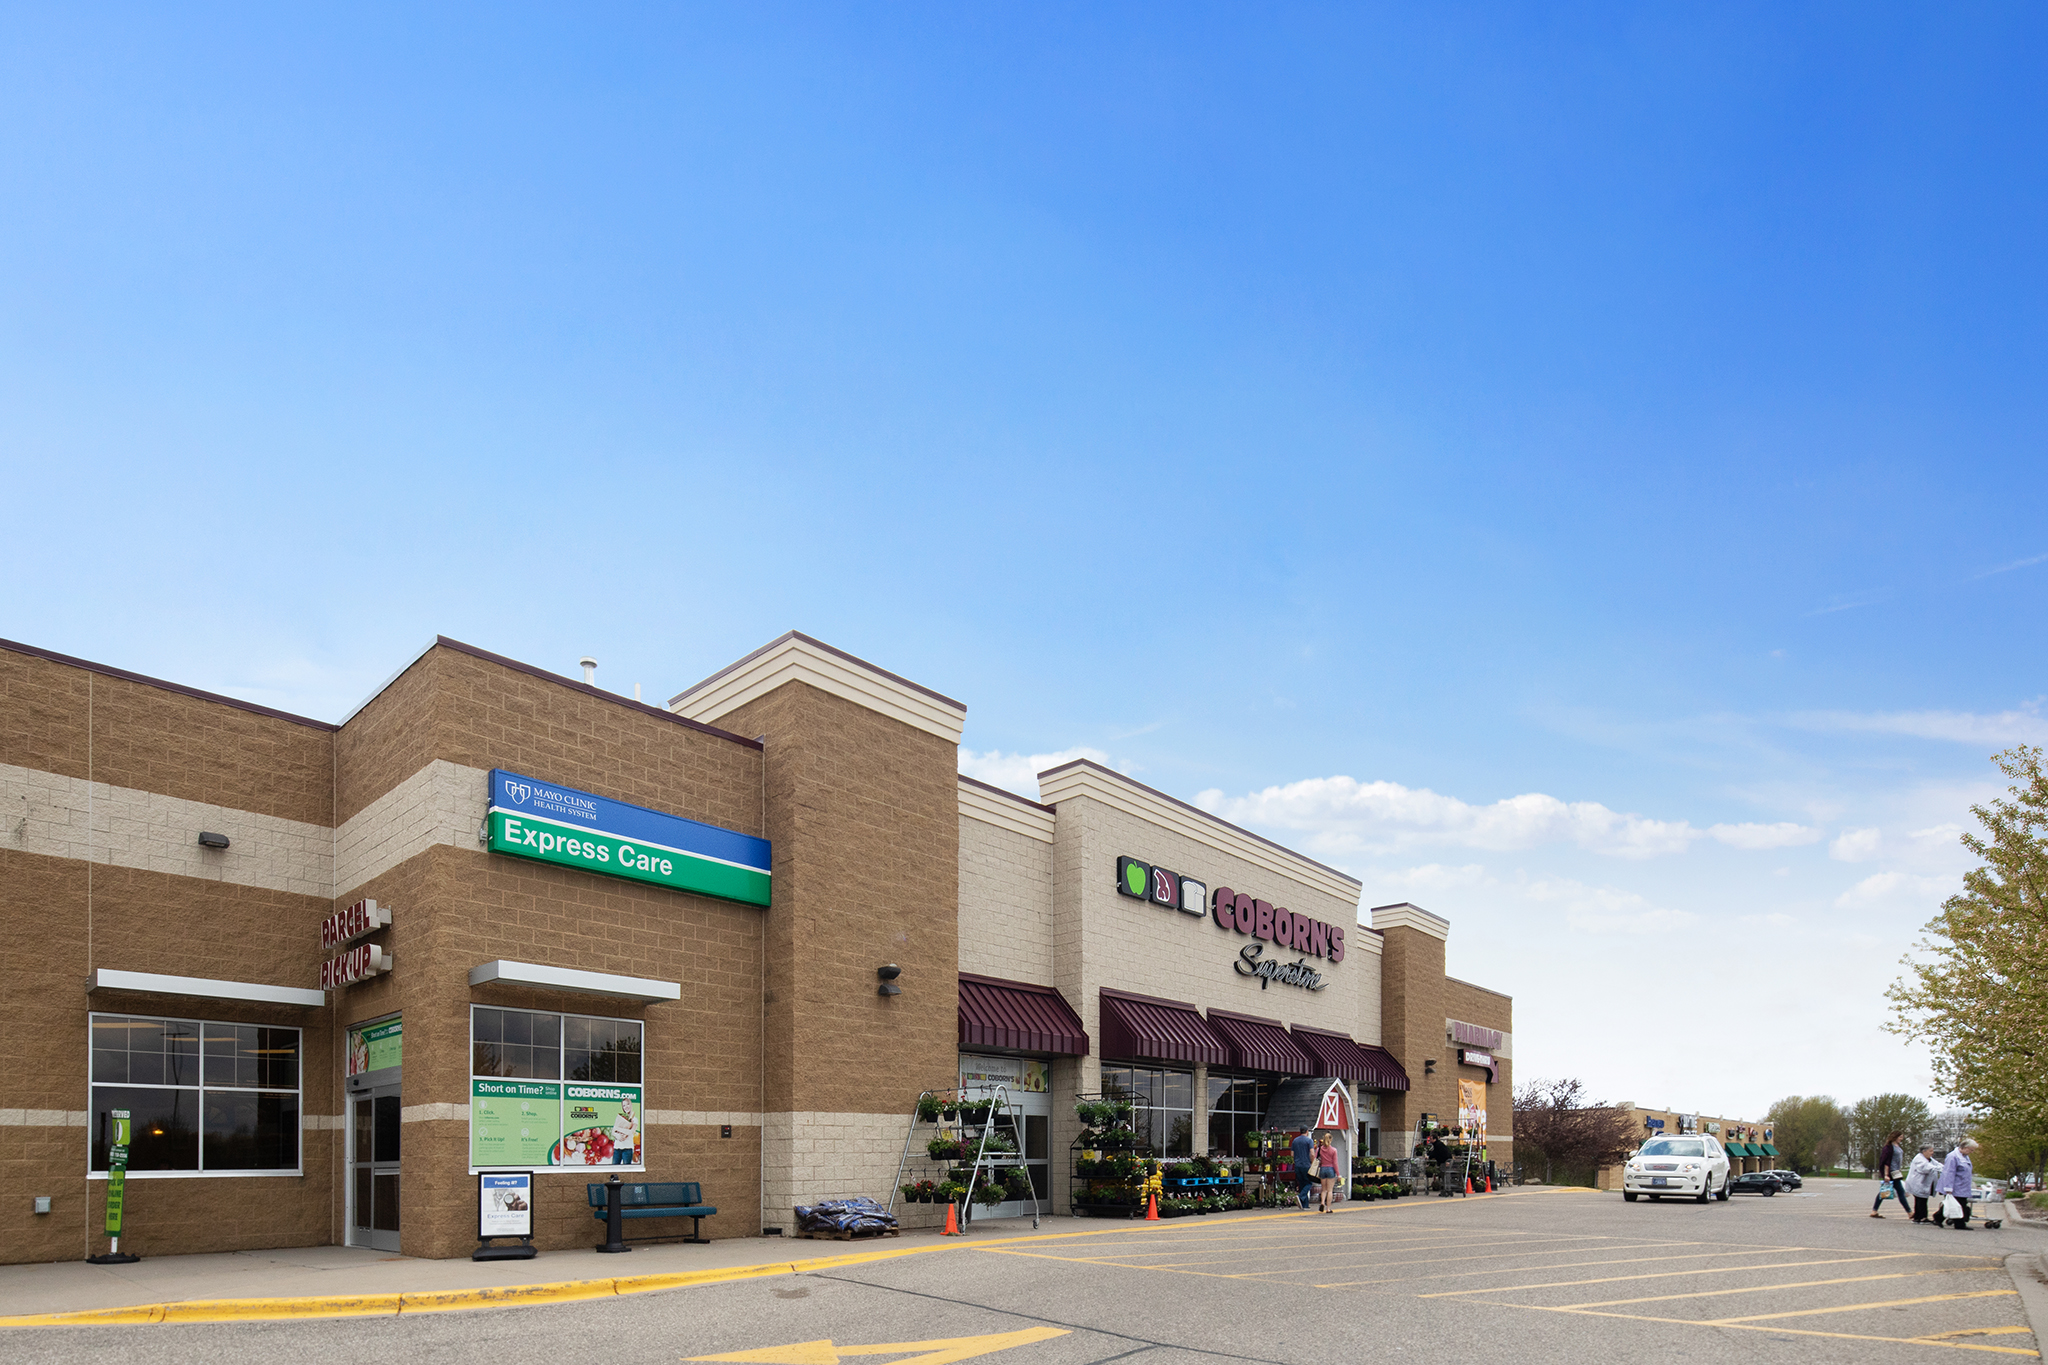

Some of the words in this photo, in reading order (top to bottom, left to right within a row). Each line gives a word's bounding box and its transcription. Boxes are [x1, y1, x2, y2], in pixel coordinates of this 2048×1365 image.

[533, 787, 562, 802] MAYO
[564, 795, 597, 811] CLINIC
[533, 799, 566, 814] HEALTH
[567, 807, 597, 821] SYSTEM
[504, 818, 610, 863] Express
[617, 845, 673, 876] Care
[321, 899, 375, 950] PARCEL
[1213, 886, 1345, 963] COBORN'S
[321, 944, 376, 991] PICK-UP
[1233, 942, 1330, 990] Superstore
[1453, 1021, 1503, 1051] PHARMACY
[975, 1062, 999, 1072] Welcome
[1001, 1065, 1007, 1073] to
[988, 1074, 1014, 1082] COBORN'S
[478, 1083, 503, 1093] Short
[505, 1086, 517, 1094] on
[518, 1085, 544, 1095] Time?
